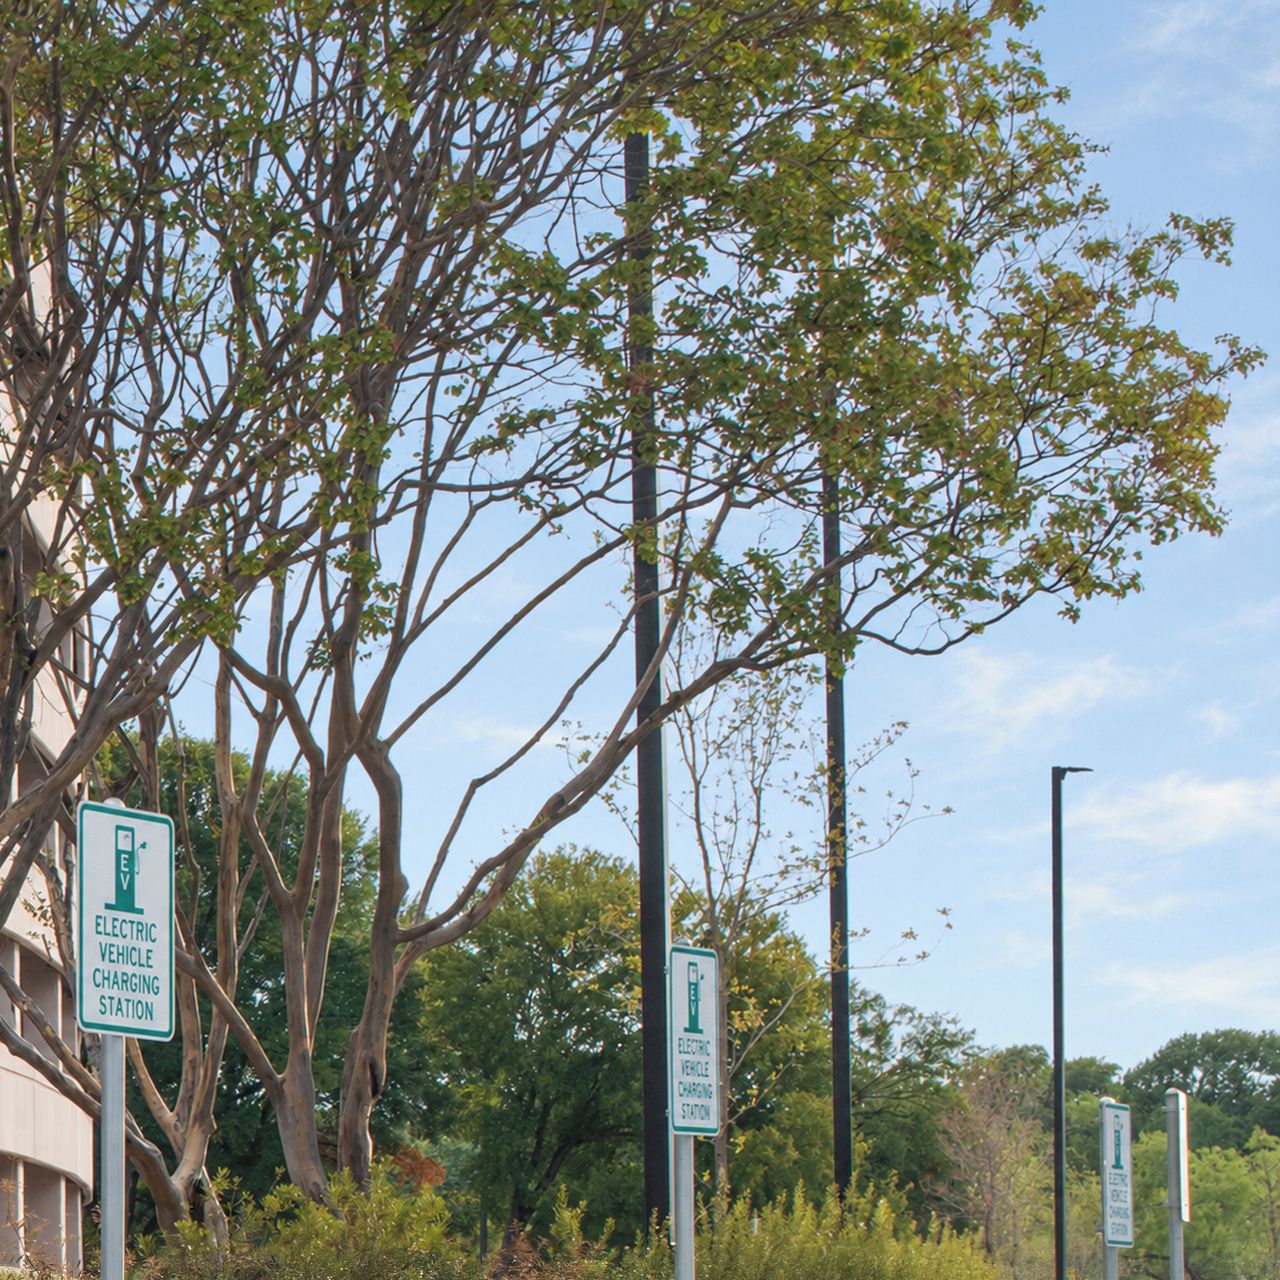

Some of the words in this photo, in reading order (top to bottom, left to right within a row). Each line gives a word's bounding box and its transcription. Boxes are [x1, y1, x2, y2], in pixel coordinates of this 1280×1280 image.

[120, 854, 130, 891] EV
[95, 914, 157, 943] ELECTRIC
[99, 941, 153, 969] VEHICLE
[93, 967, 160, 996] CHARGING
[99, 994, 153, 1021] STATION
[678, 1037, 710, 1056] ELECTRIC
[681, 1059, 709, 1078] VEHICLE
[681, 1103, 711, 1120] STATION
